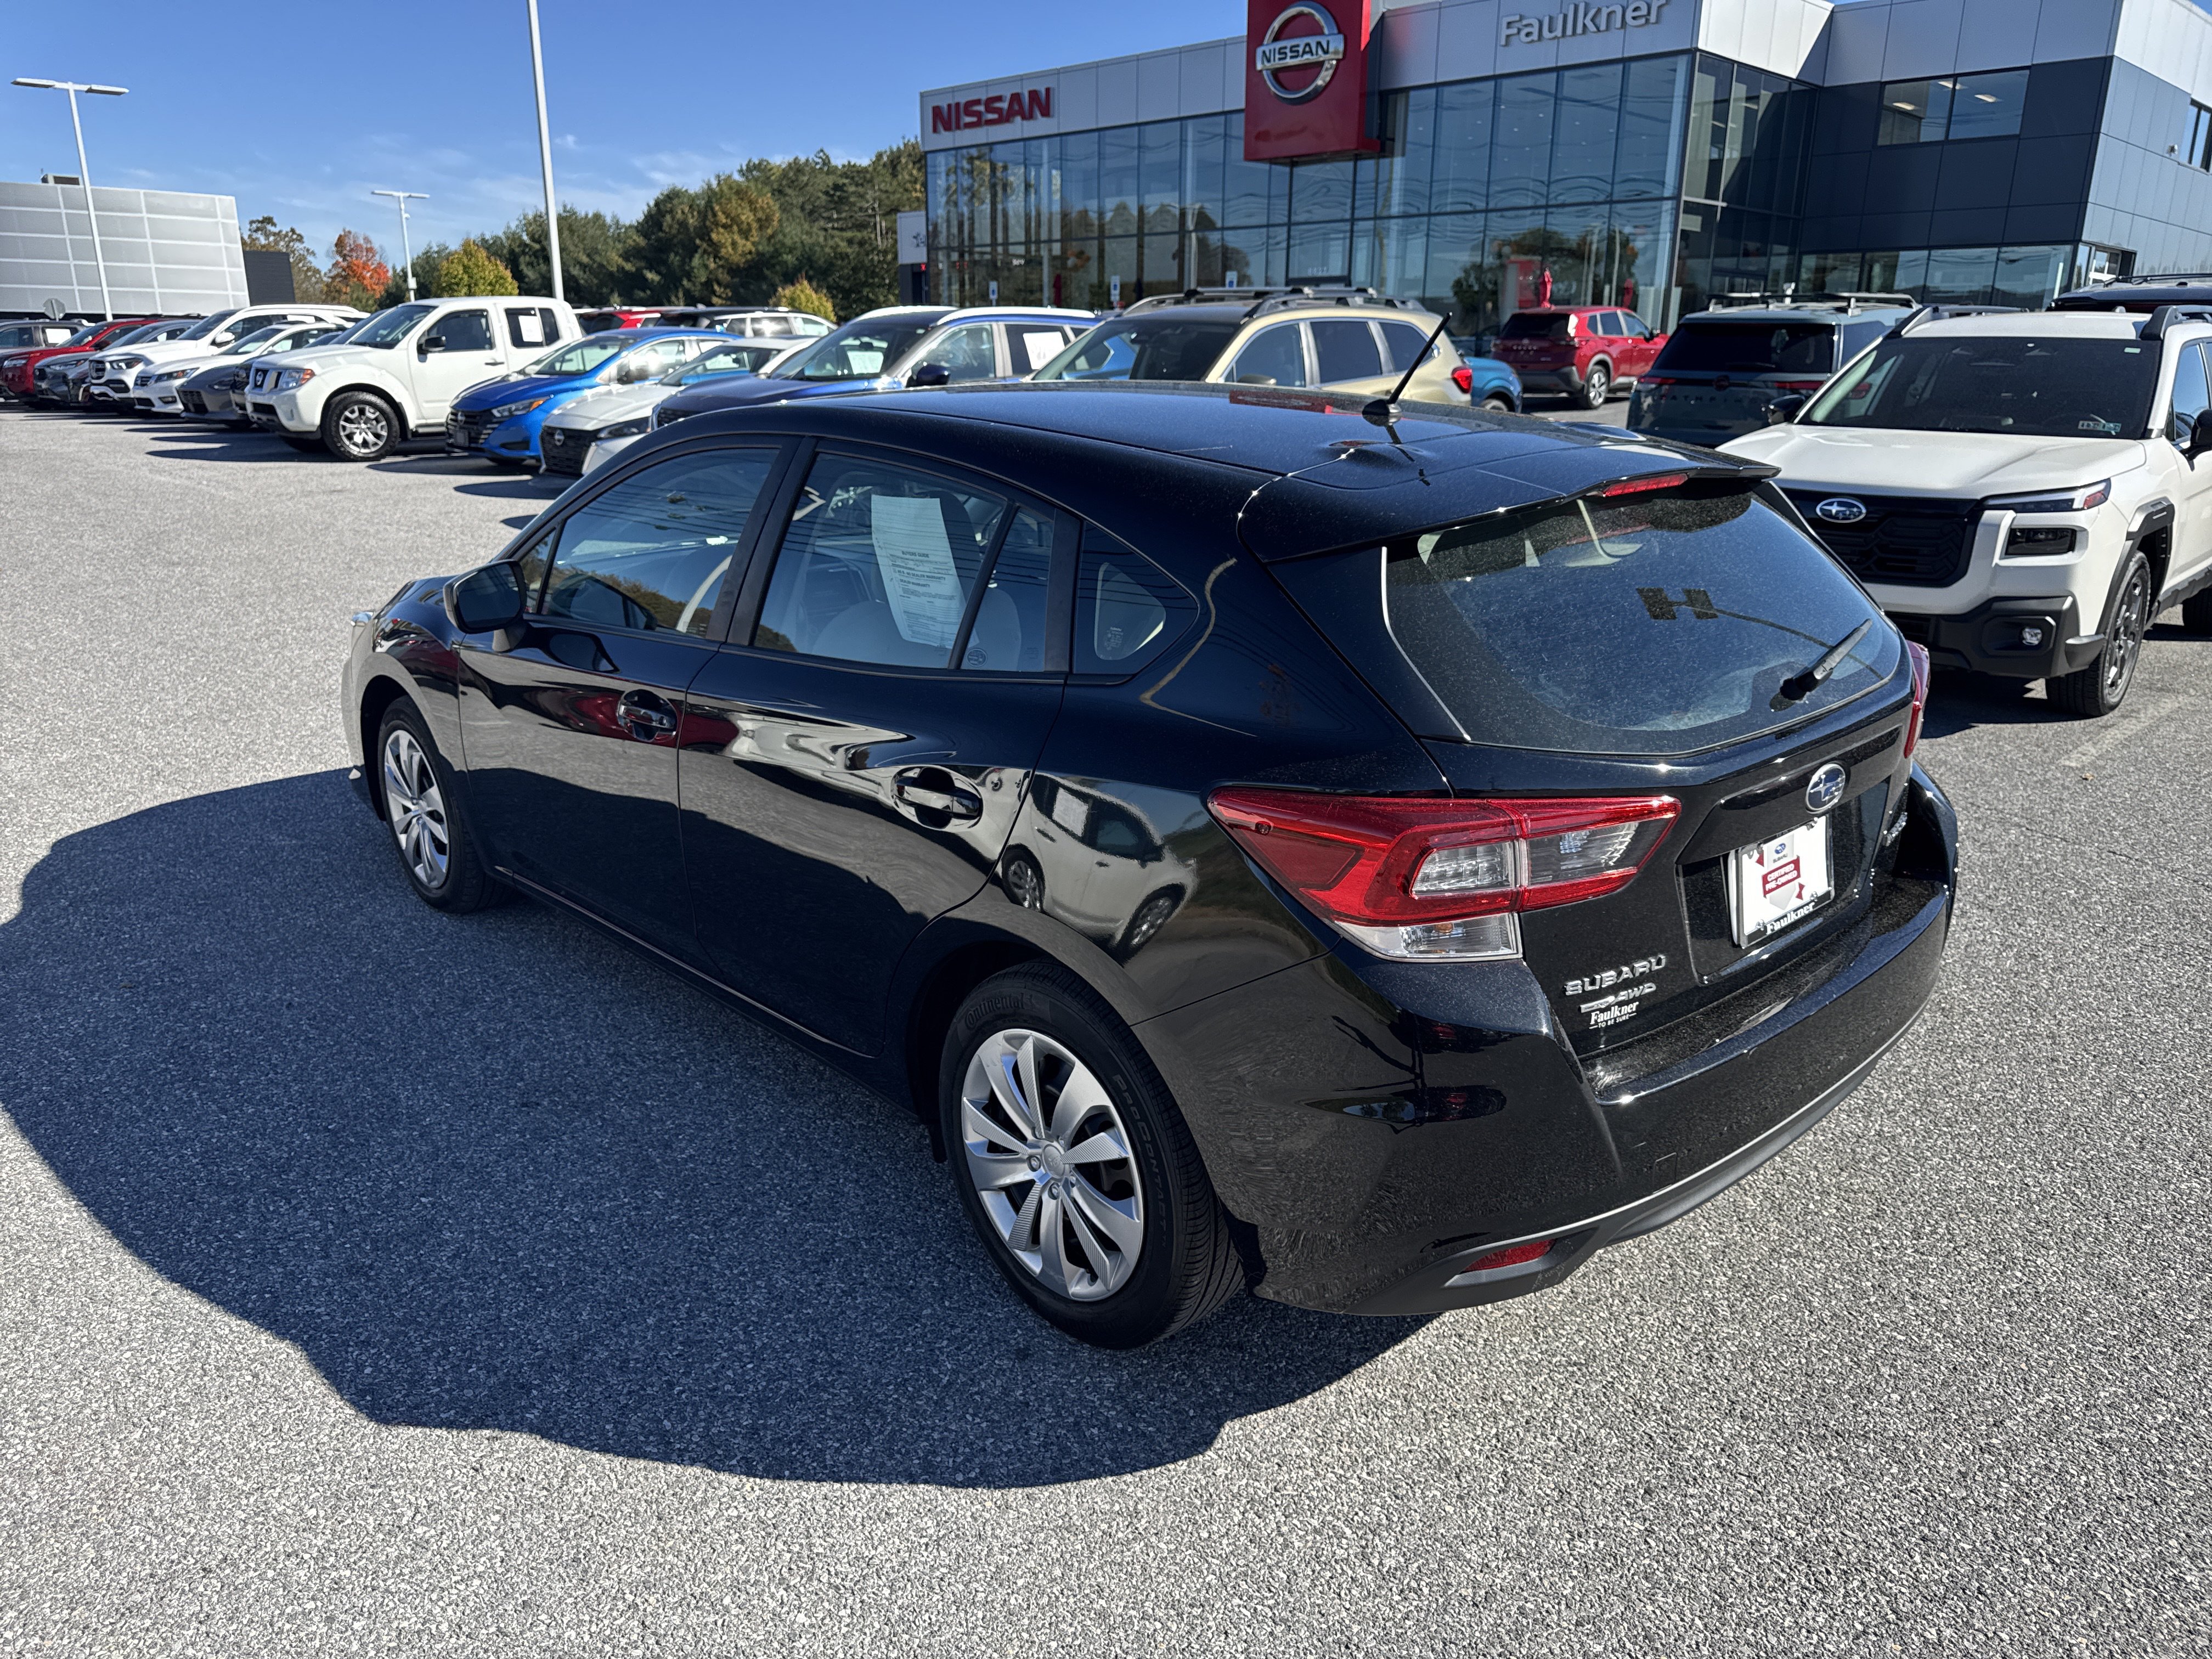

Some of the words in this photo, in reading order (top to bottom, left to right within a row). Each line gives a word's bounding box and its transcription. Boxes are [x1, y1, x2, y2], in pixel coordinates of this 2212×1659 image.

[1499, 0, 1668, 47] Faulkner
[1260, 40, 1330, 65] NISSAN
[932, 87, 1052, 134] NISSAN
[1773, 853, 1788, 864] SUBARU
[1765, 870, 1798, 891] PRE-OWNED
[1767, 863, 1795, 882] CERTIFIED
[1765, 901, 1815, 935] Faulkner
[1562, 953, 1666, 996] SUBARU
[1611, 982, 1657, 1005] AWD
[964, 992, 1025, 1030] Continental
[1589, 1001, 1639, 1025] Faulkner
[1616, 1014, 1630, 1023] SURE
